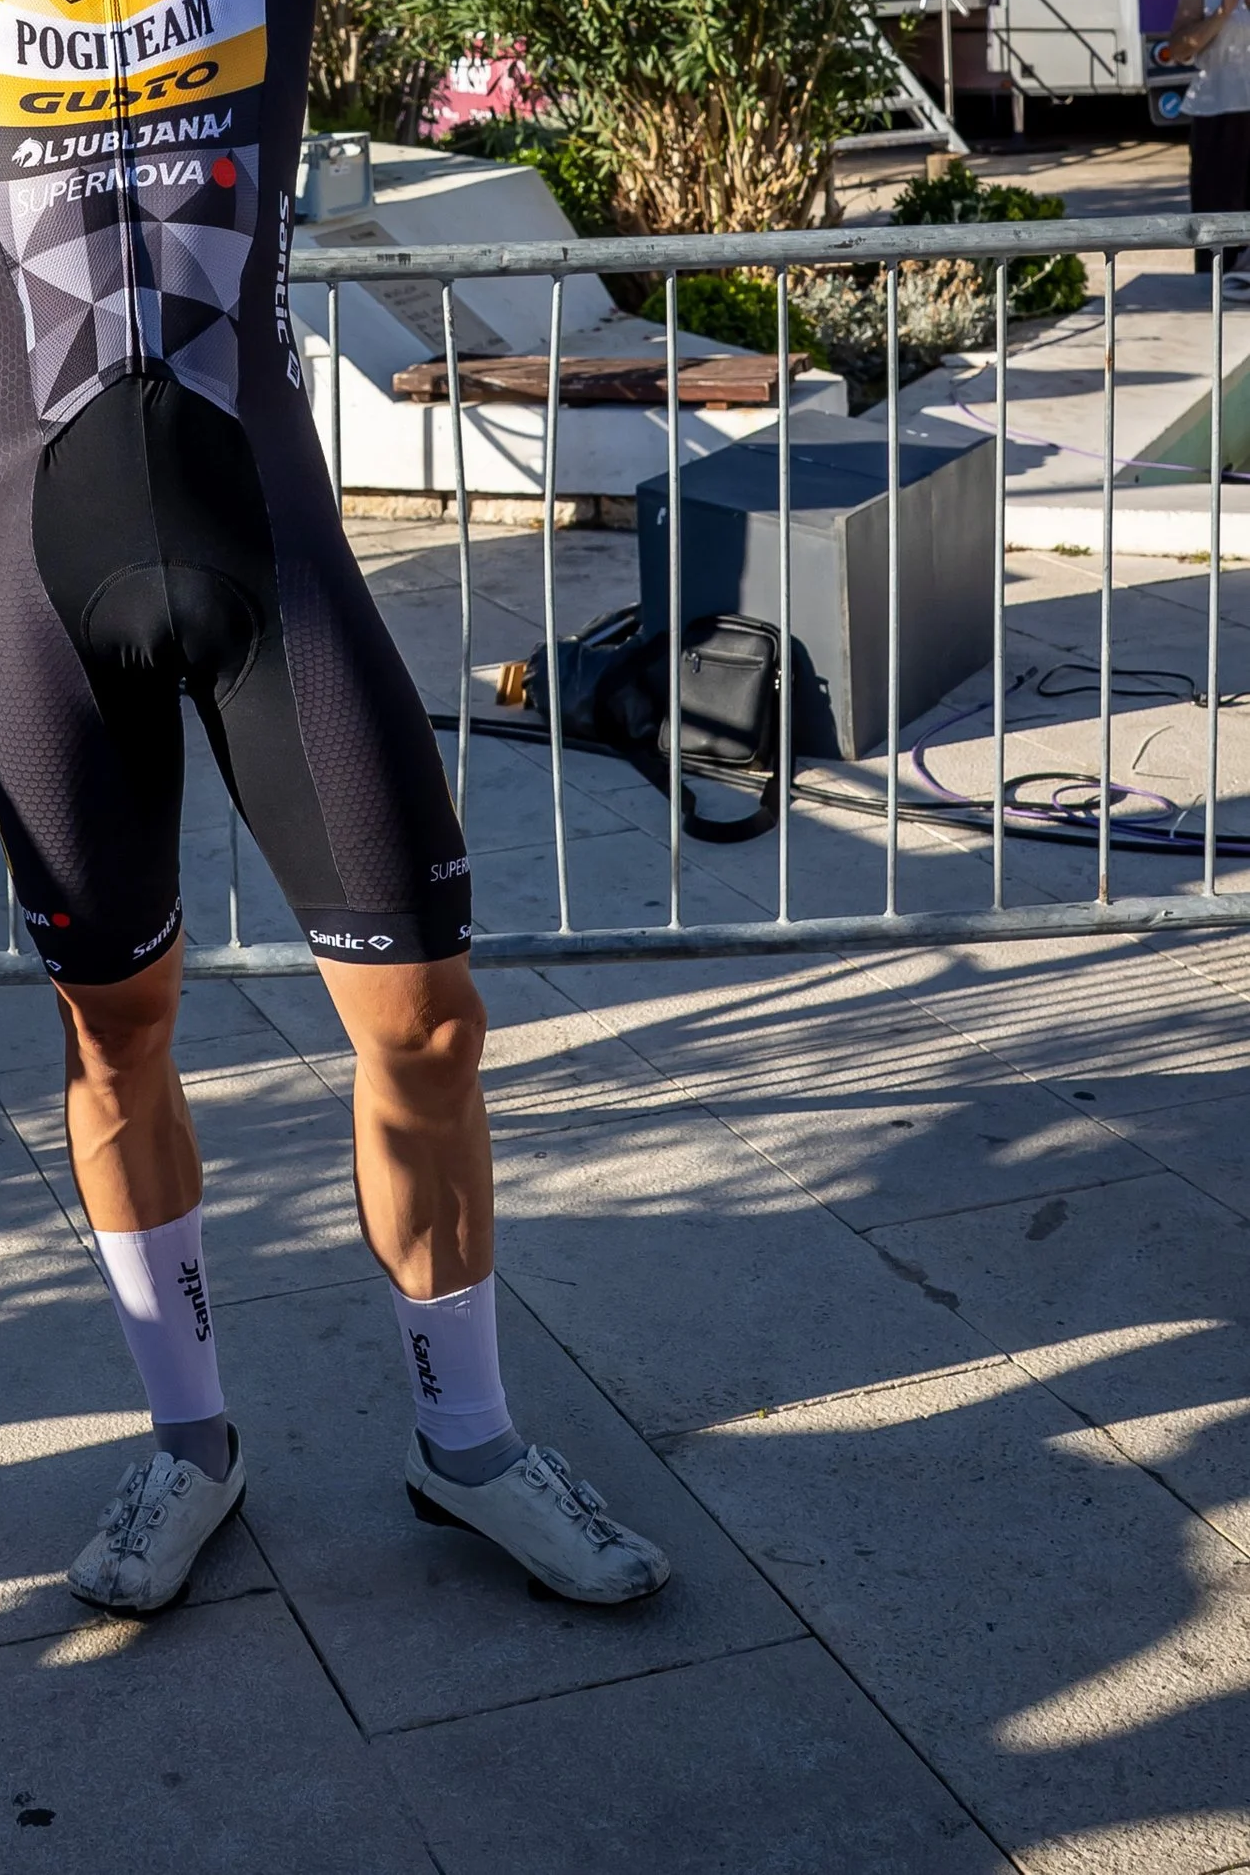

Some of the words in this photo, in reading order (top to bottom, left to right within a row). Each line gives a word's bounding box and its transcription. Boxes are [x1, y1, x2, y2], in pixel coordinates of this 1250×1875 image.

[19, 60, 220, 114] GUSTO
[43, 110, 227, 165] LJUBLJANA
[16, 159, 205, 219] SUPERNOVA
[274, 189, 296, 346] Santic
[132, 908, 178, 960] Santic
[309, 929, 365, 950] Santic
[177, 1258, 212, 1342] Santic
[408, 1327, 443, 1405] Santic
